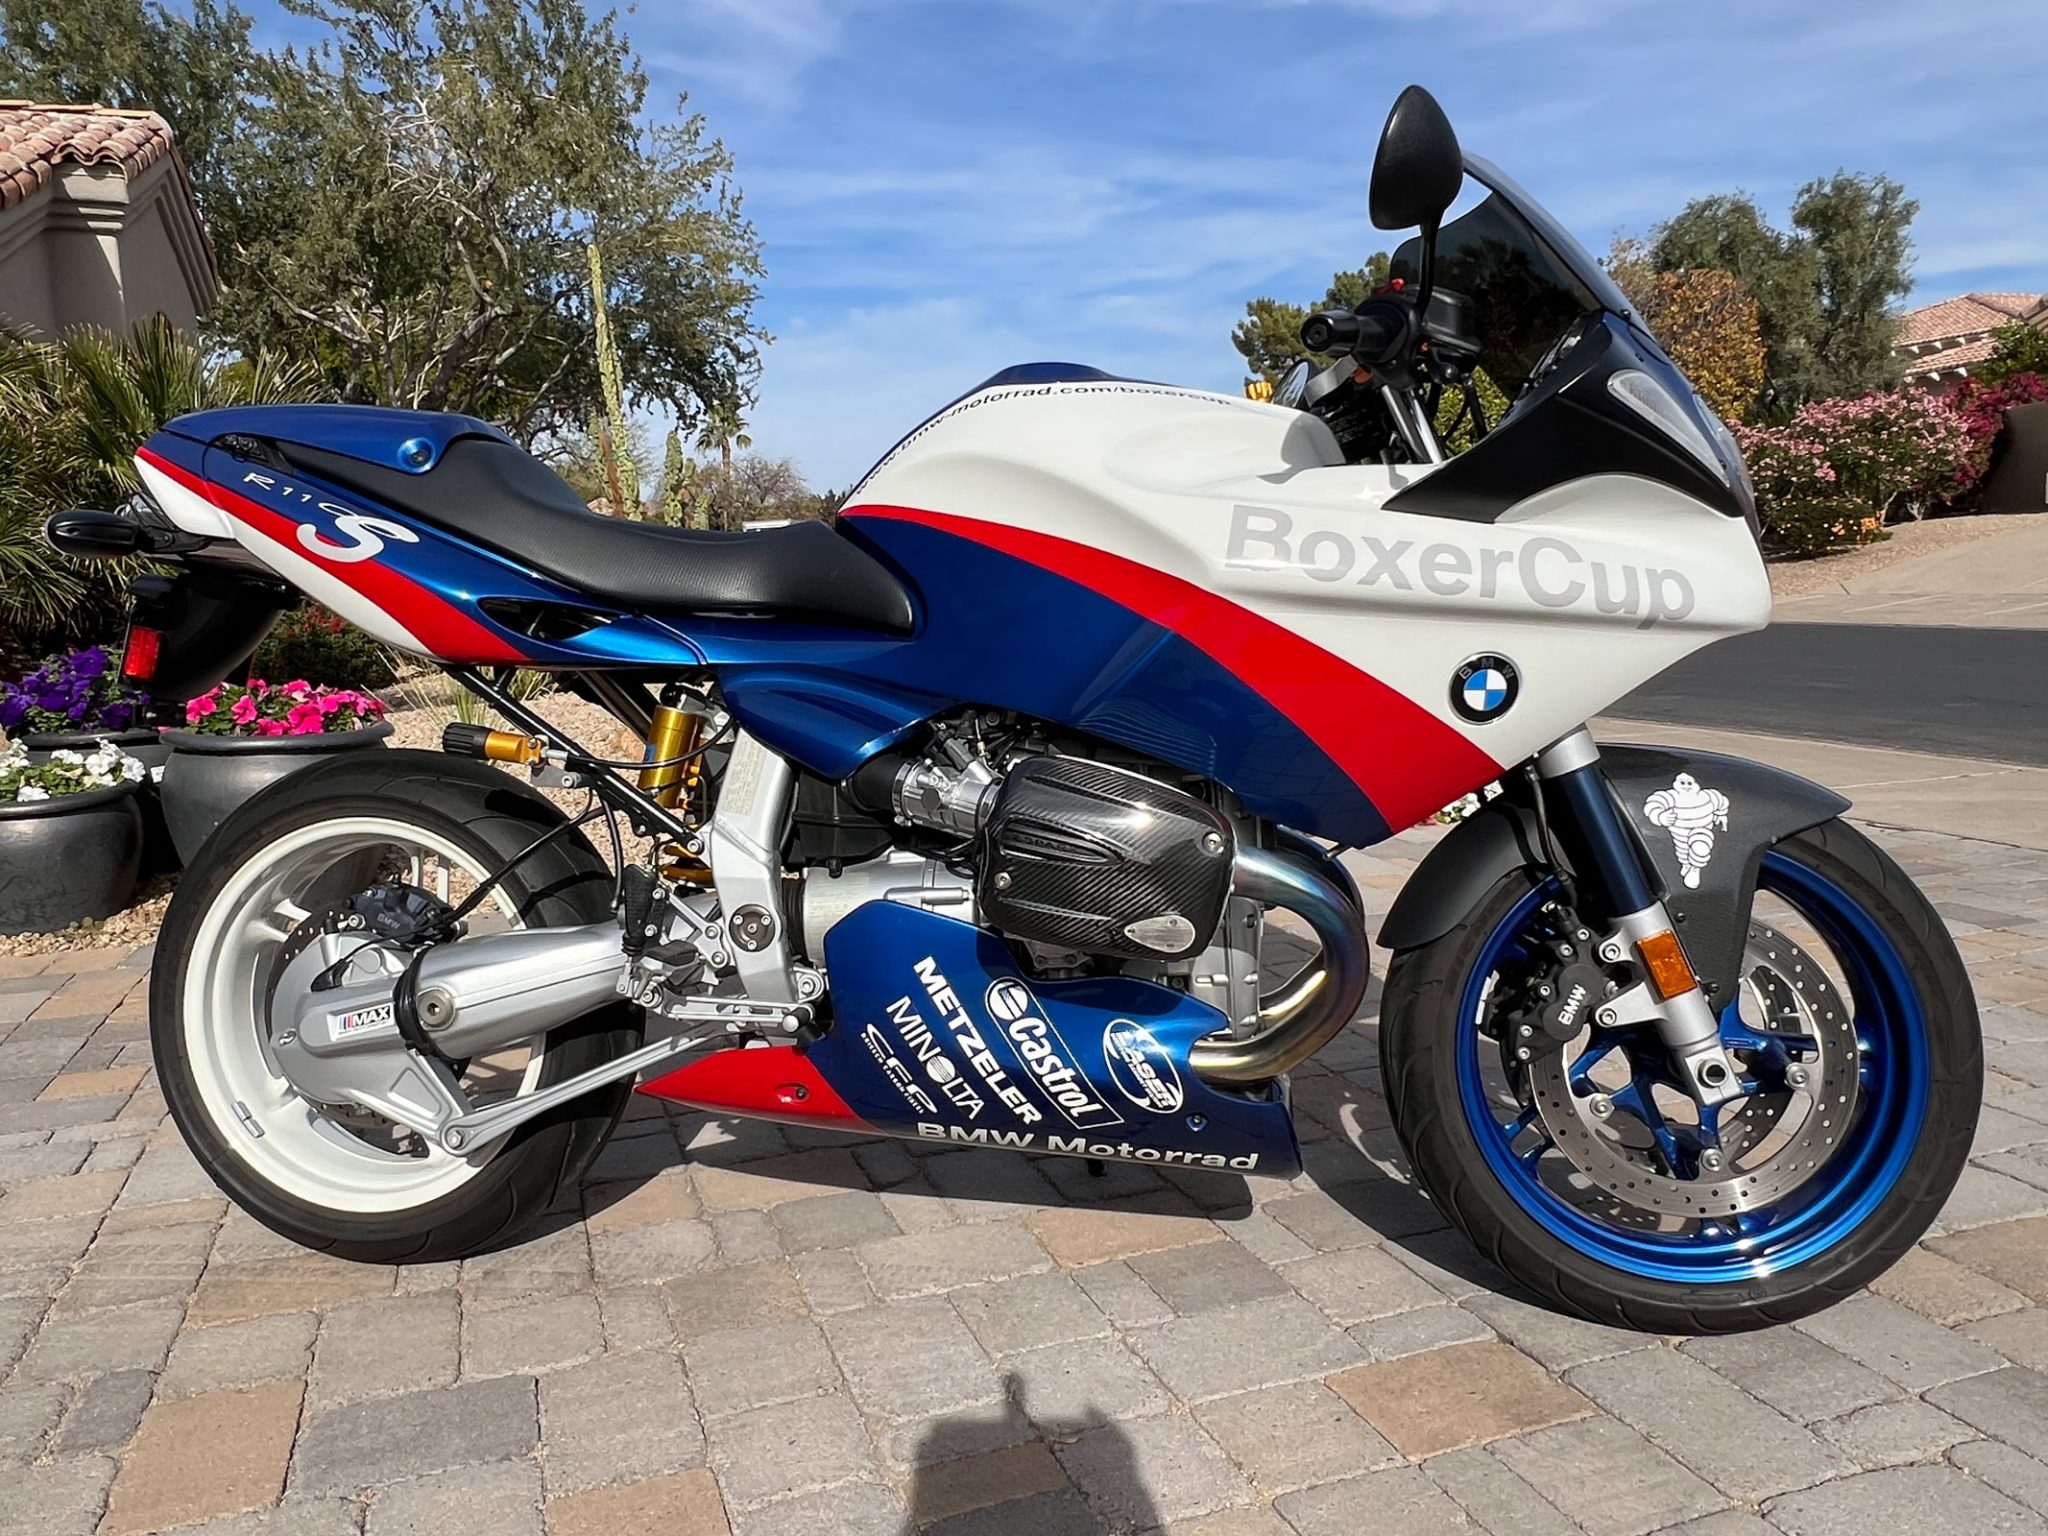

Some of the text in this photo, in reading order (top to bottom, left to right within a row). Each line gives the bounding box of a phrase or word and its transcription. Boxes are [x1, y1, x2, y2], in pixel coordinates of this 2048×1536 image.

[1225, 504, 1695, 630] BoxerCup
[1458, 657, 1515, 680] BMW
[377, 913, 401, 929] BMW
[351, 1006, 389, 1027] MAX
[1557, 983, 1586, 1026] BMW
[886, 995, 985, 1120] MINOLTA
[913, 956, 1043, 1125] METZELER
[1010, 1018, 1103, 1118] Castrol
[1114, 1031, 1178, 1106] LASER
[917, 1121, 1261, 1171] BMW Motorrad
